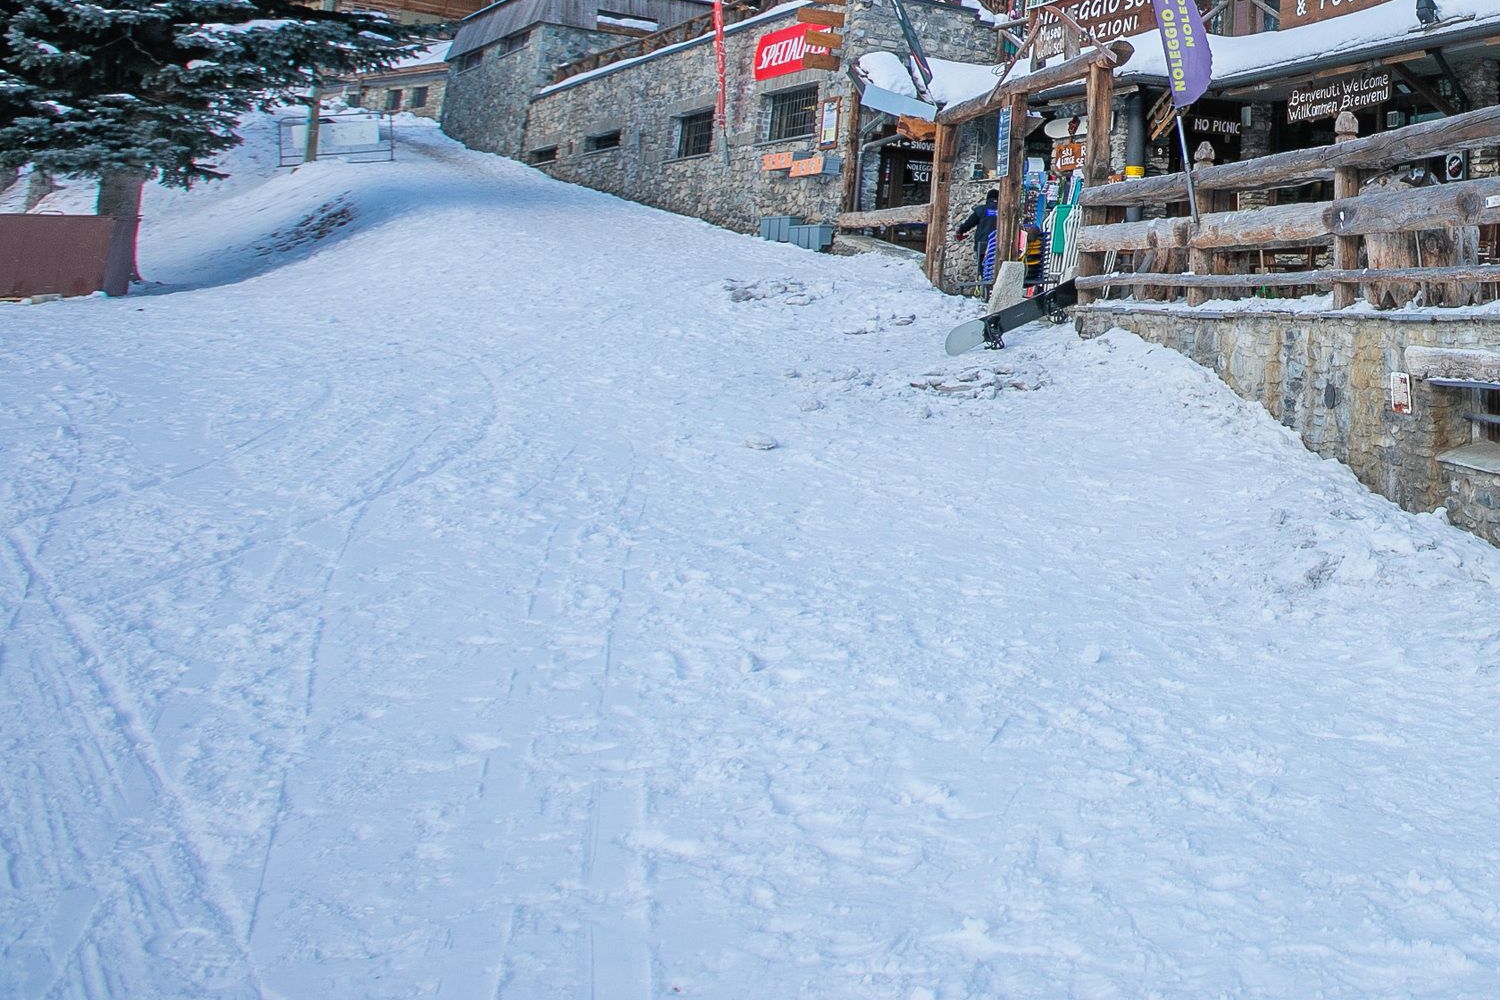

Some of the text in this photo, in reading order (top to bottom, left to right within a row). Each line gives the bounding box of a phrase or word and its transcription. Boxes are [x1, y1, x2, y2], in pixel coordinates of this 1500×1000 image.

[757, 27, 831, 70] SPECIAL
[1161, 8, 1187, 93] NOLEGGIO
[1343, 73, 1389, 95] Welcome
[1194, 118, 1210, 131] NO
[913, 171, 929, 182] SCI
